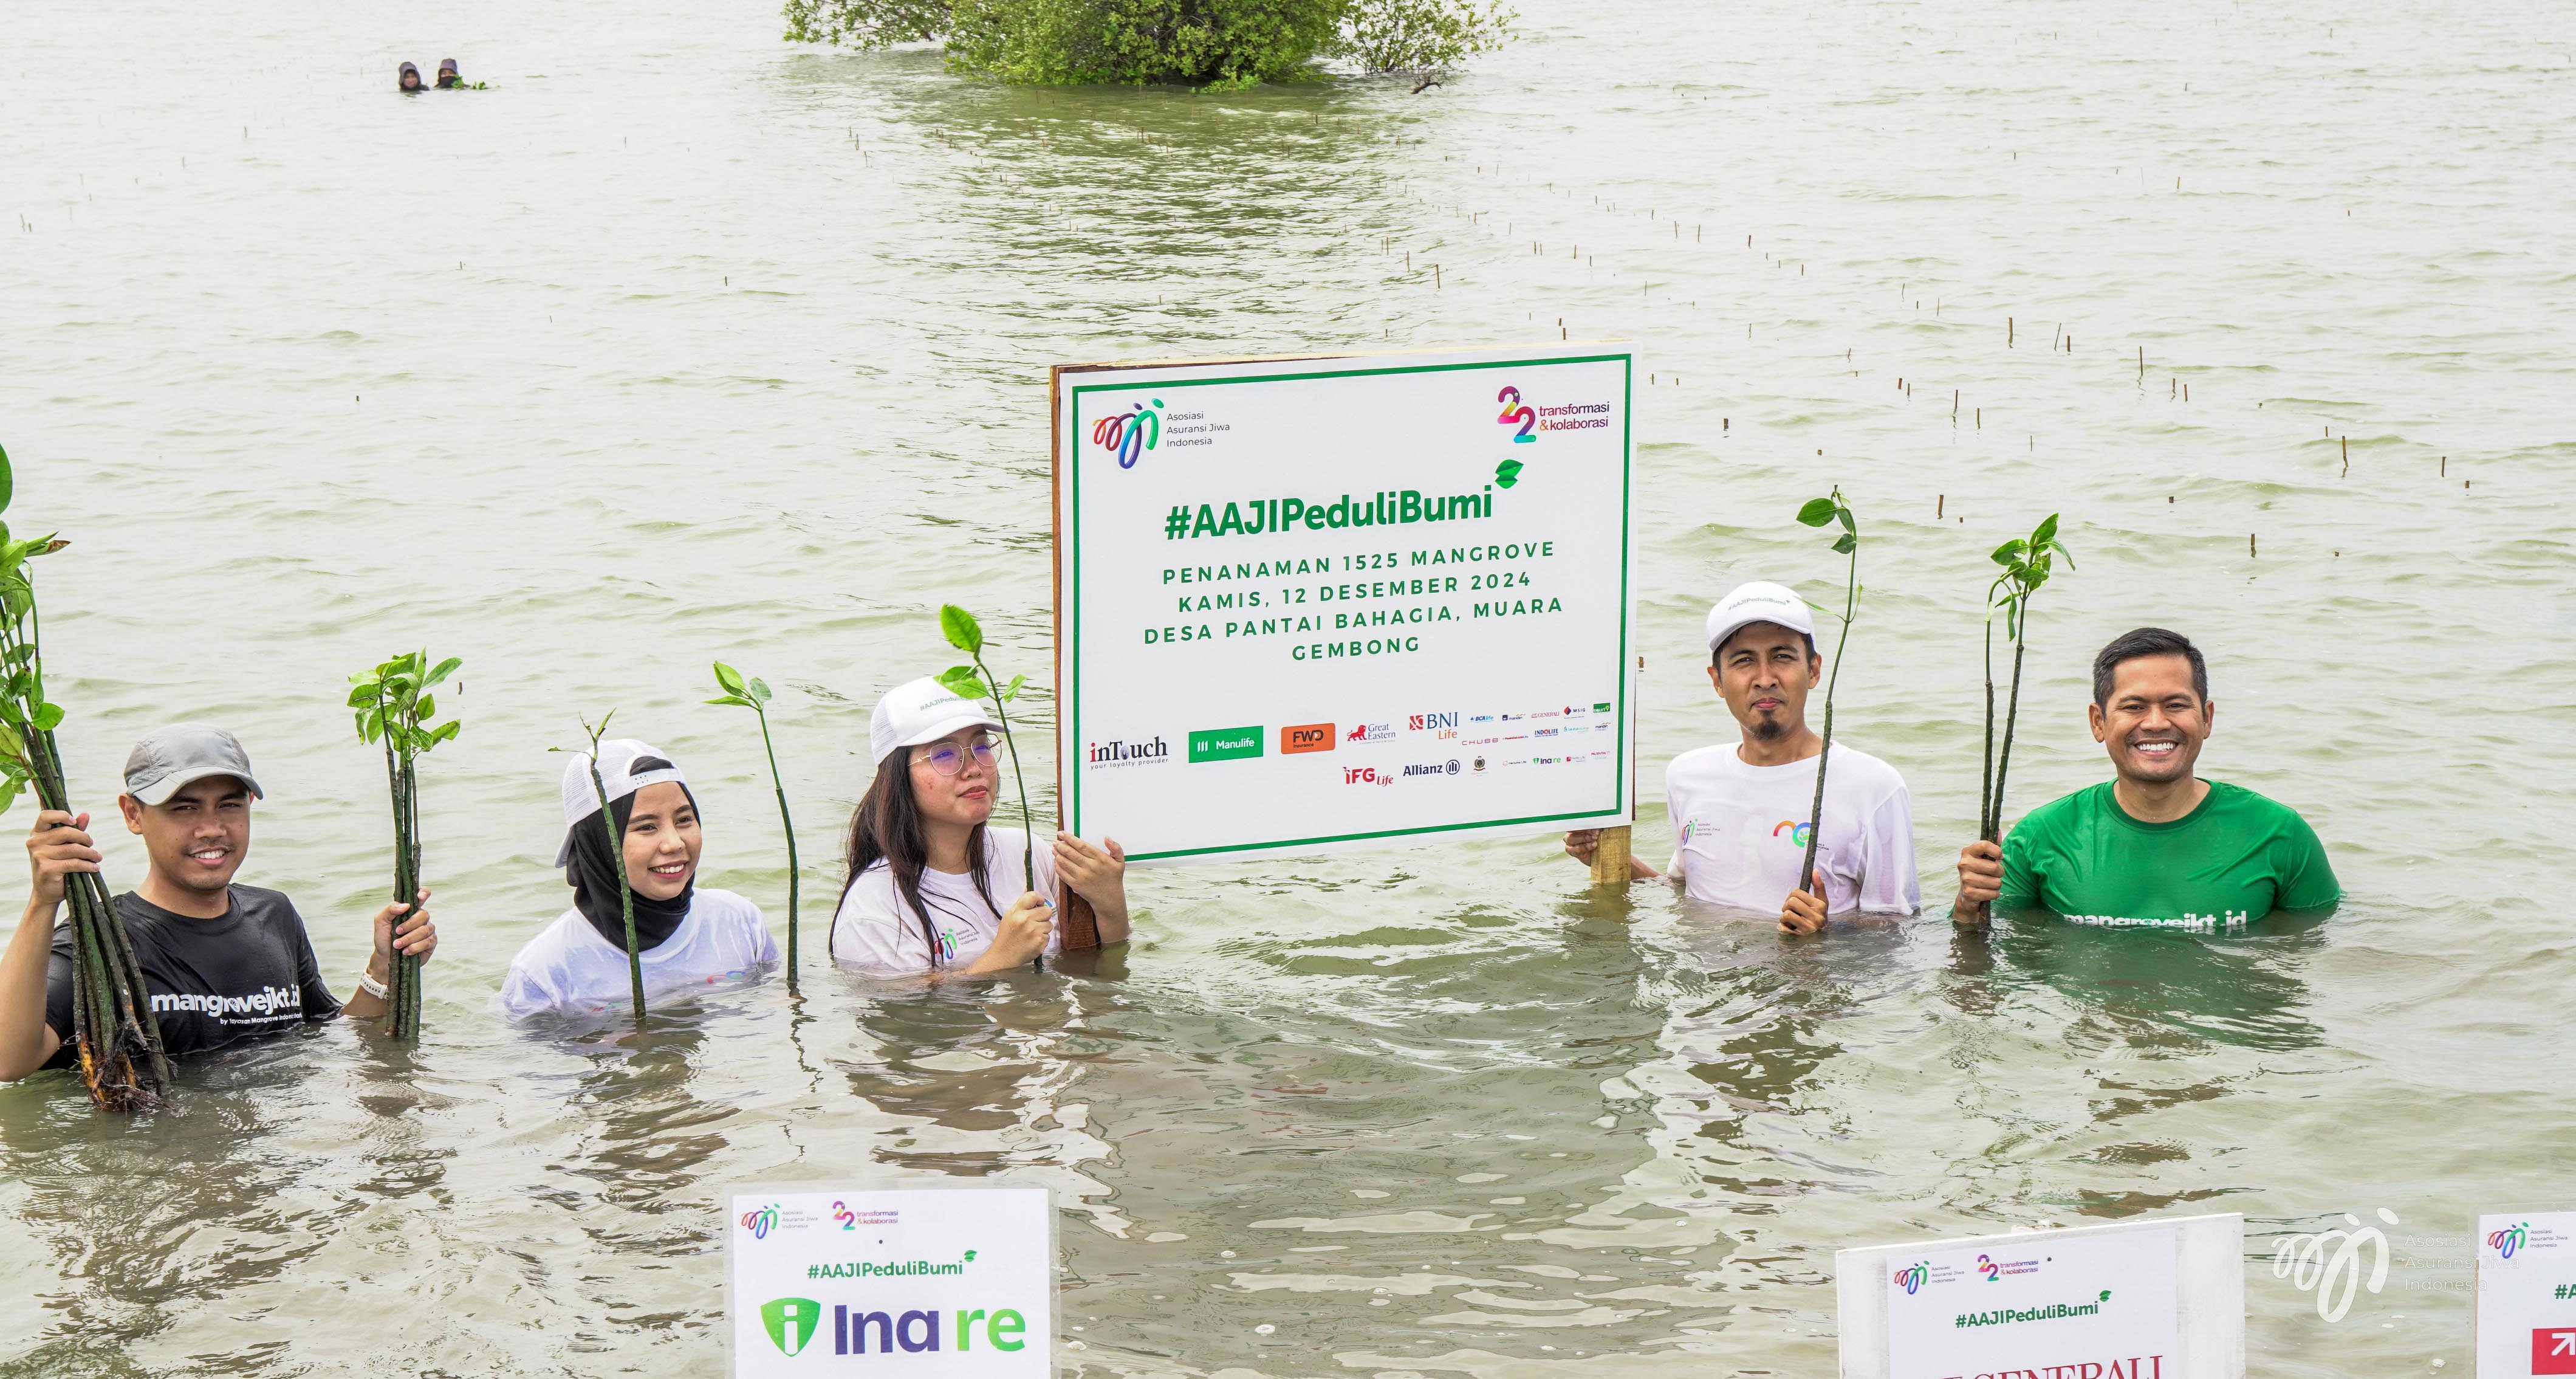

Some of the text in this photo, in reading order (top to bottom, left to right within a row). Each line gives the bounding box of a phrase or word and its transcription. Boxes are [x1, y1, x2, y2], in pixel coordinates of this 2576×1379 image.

[1166, 411, 1204, 421] Asosiasi
[1539, 401, 1609, 417] transformasi
[1166, 423, 1230, 434] Asuransi Jiwa
[1167, 437, 1212, 447] Indonesia
[1164, 484, 1492, 540] #AAJIPeduliBumi
[1163, 541, 1553, 585] PENANAMAN 1525 MANGROVE
[1179, 571, 1530, 613] KAMIS, 12 DESEMBER 2024
[1144, 597, 1562, 644] DESA PANTAI BAHAGIA, MUARA
[1292, 636, 1419, 661] GEMBONG
[1368, 723, 1389, 732] Great
[1427, 712, 1458, 729] BNI
[1293, 729, 1324, 743] FWD
[1368, 731, 1396, 740] Eastern
[1438, 729, 1458, 740] Life
[1216, 737, 1255, 750] Manulife
[1403, 764, 1443, 777] Allianz
[1377, 775, 1394, 787] Life
[151, 983, 300, 1017] mangrovejkt.id
[251, 1016, 279, 1024] Mangrove
[807, 1260, 964, 1279] #AAJIPeduliBumi
[2000, 1259, 2038, 1269] transformasi
[1955, 1301, 2098, 1329] #AAJIPeduliBumi
[835, 1305, 1026, 1355] Ina re
